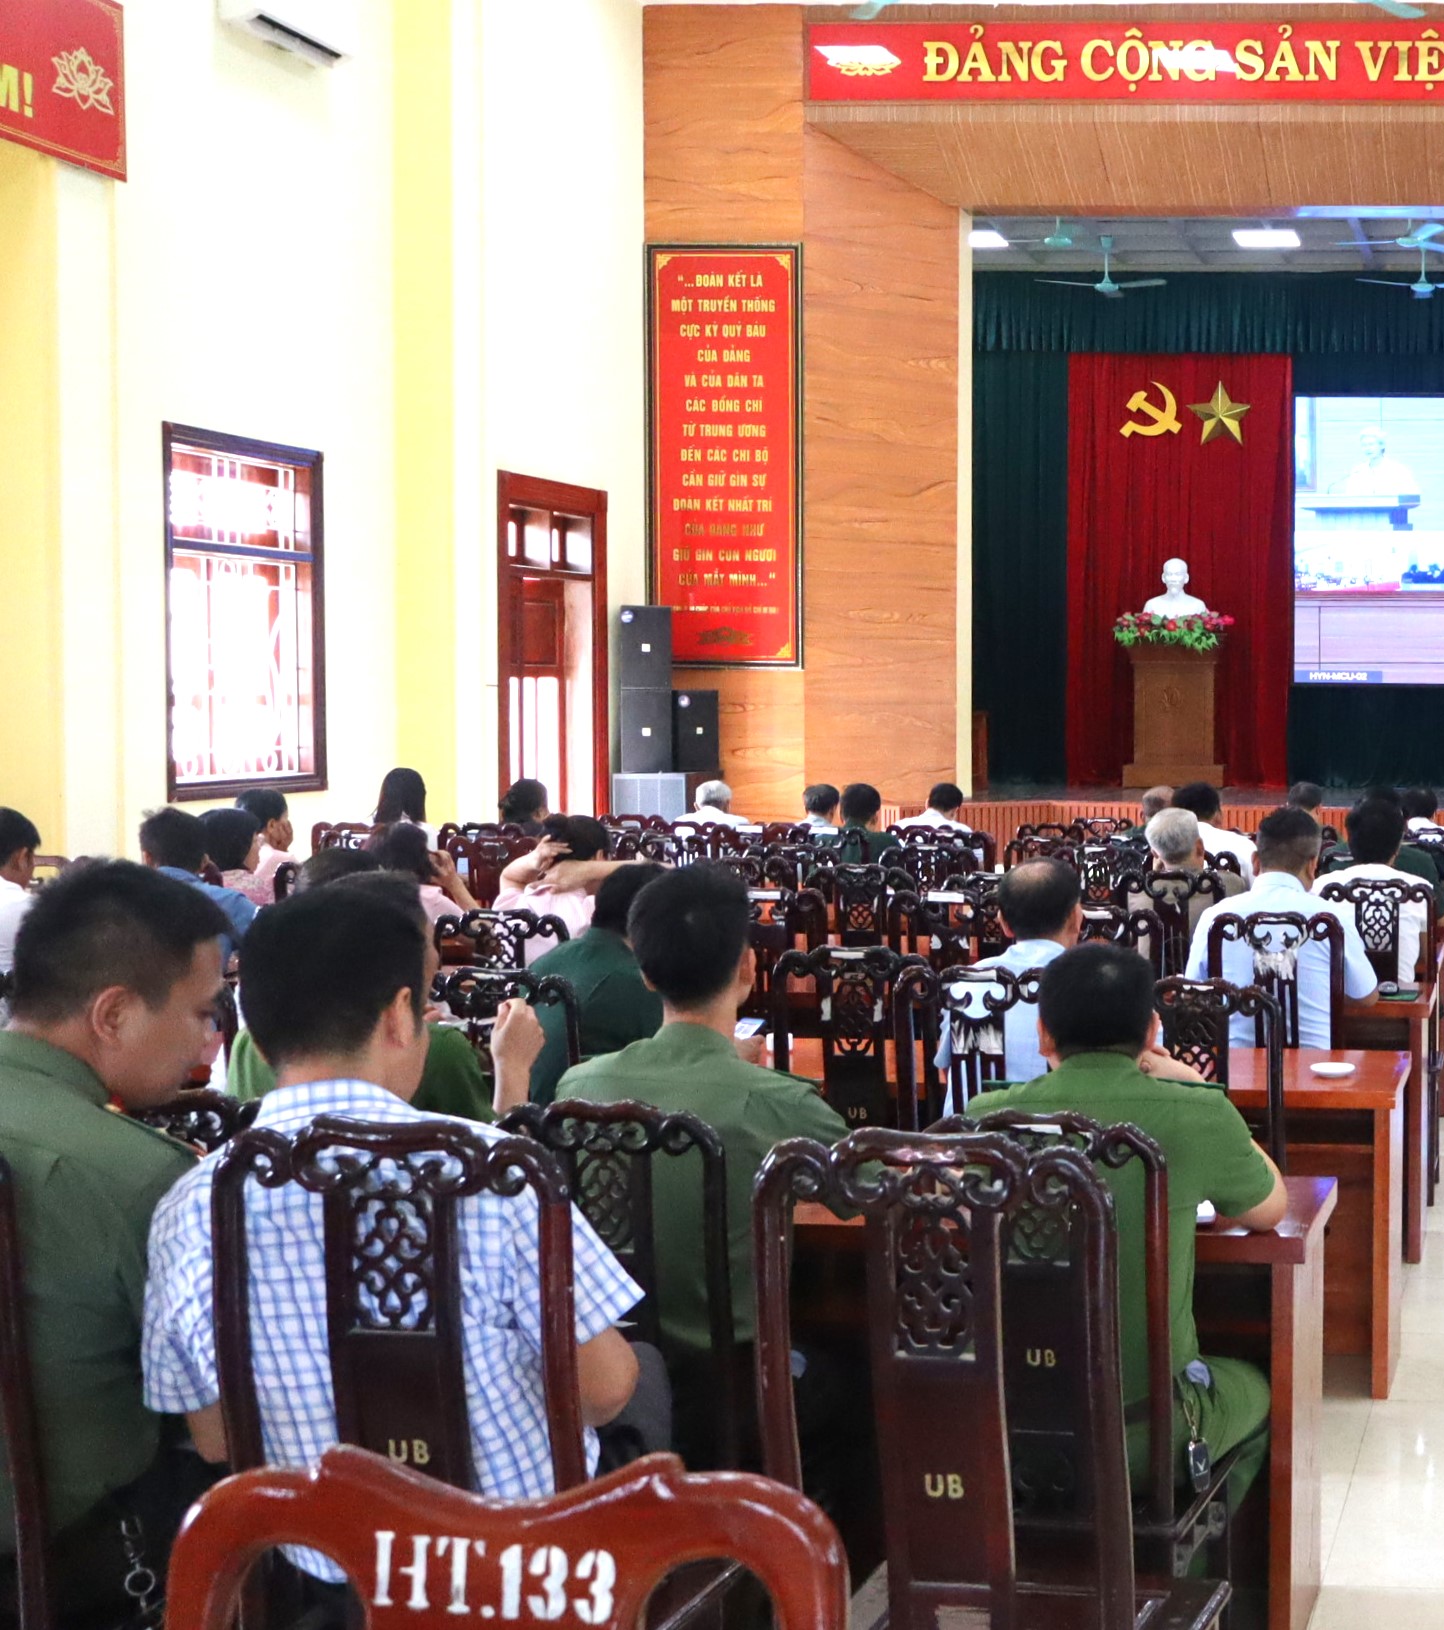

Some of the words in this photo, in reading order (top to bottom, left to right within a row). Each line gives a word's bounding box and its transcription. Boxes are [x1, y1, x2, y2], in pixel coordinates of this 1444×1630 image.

[922, 24, 1067, 82] ĐẢNG
[1080, 27, 1216, 92] CỘNG
[1234, 24, 1341, 82] SẢN
[728, 270, 746, 287] KẾT
[671, 296, 693, 315] MỘT
[680, 324, 700, 340] CỰC
[697, 344, 717, 362] CỦA
[723, 344, 750, 362] ĐẢNG
[702, 370, 722, 387] CỦA
[753, 375, 764, 387] TA
[686, 396, 706, 412] CÁC
[700, 424, 733, 437] TRUNG
[738, 424, 766, 437] ƯƠNG
[707, 446, 727, 461] CÁC
[733, 449, 750, 461] CHI
[755, 446, 768, 465] BỘ
[752, 474, 766, 490] SỰ
[706, 495, 724, 511] KẾT
[1309, 672, 1368, 680] HYN-MCU-02
[848, 1106, 868, 1119] UB
[1026, 1349, 1057, 1367] UB
[388, 1439, 431, 1464] UB
[924, 1473, 964, 1498] UB
[373, 1530, 617, 1624] HT.133
